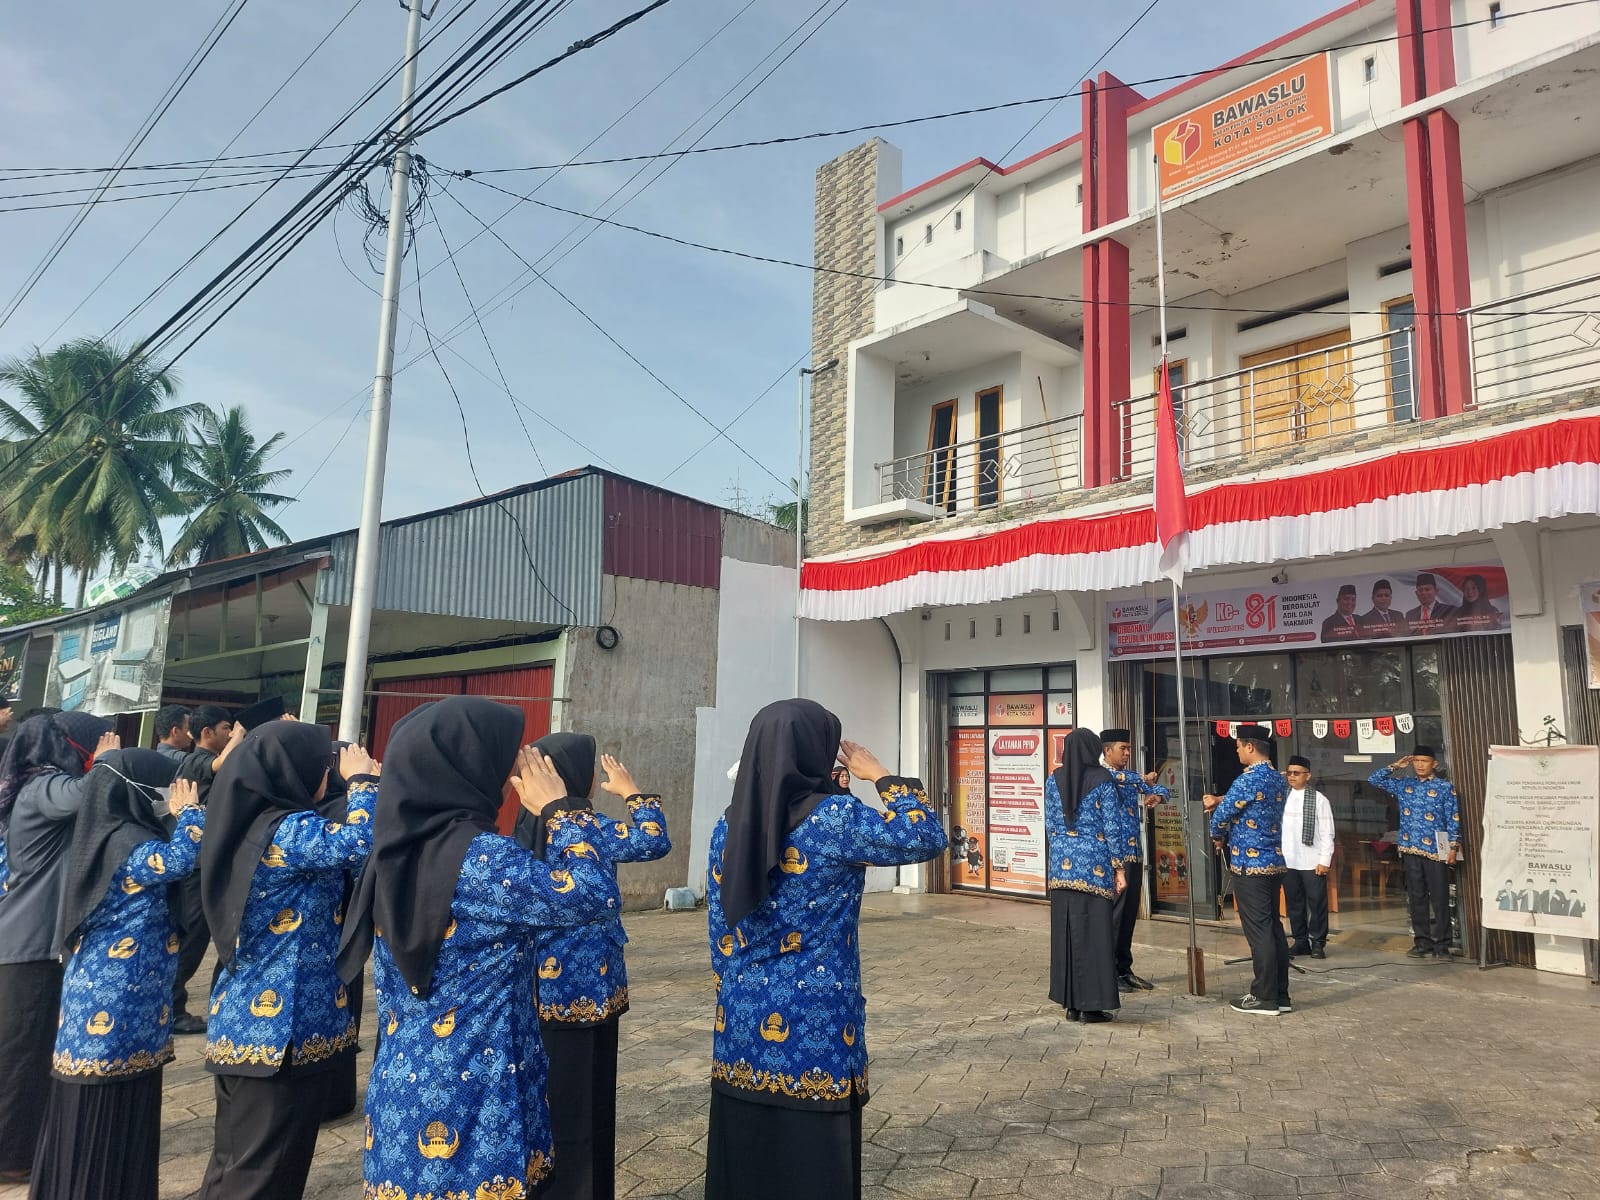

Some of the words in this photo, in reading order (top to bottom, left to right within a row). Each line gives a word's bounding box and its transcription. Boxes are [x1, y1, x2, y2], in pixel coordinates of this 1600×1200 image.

[1213, 75, 1305, 129] BAWASLU
[1214, 127, 1250, 149] KOTA
[1256, 104, 1306, 131] SOLOK
[1282, 593, 1317, 602] INDONESIA
[1122, 605, 1149, 613] BAWASLU
[1282, 602, 1320, 611] BERDAULAT
[1216, 603, 1240, 621] Ke-
[1245, 593, 1279, 632] 81
[1283, 611, 1297, 619] ADIL
[1299, 610, 1313, 618] DAN
[1283, 618, 1314, 627] MAKMUR
[998, 740, 1022, 750] LAYANAN
[1022, 739, 1035, 749] PPID
[1528, 862, 1572, 871] BAWASLU
